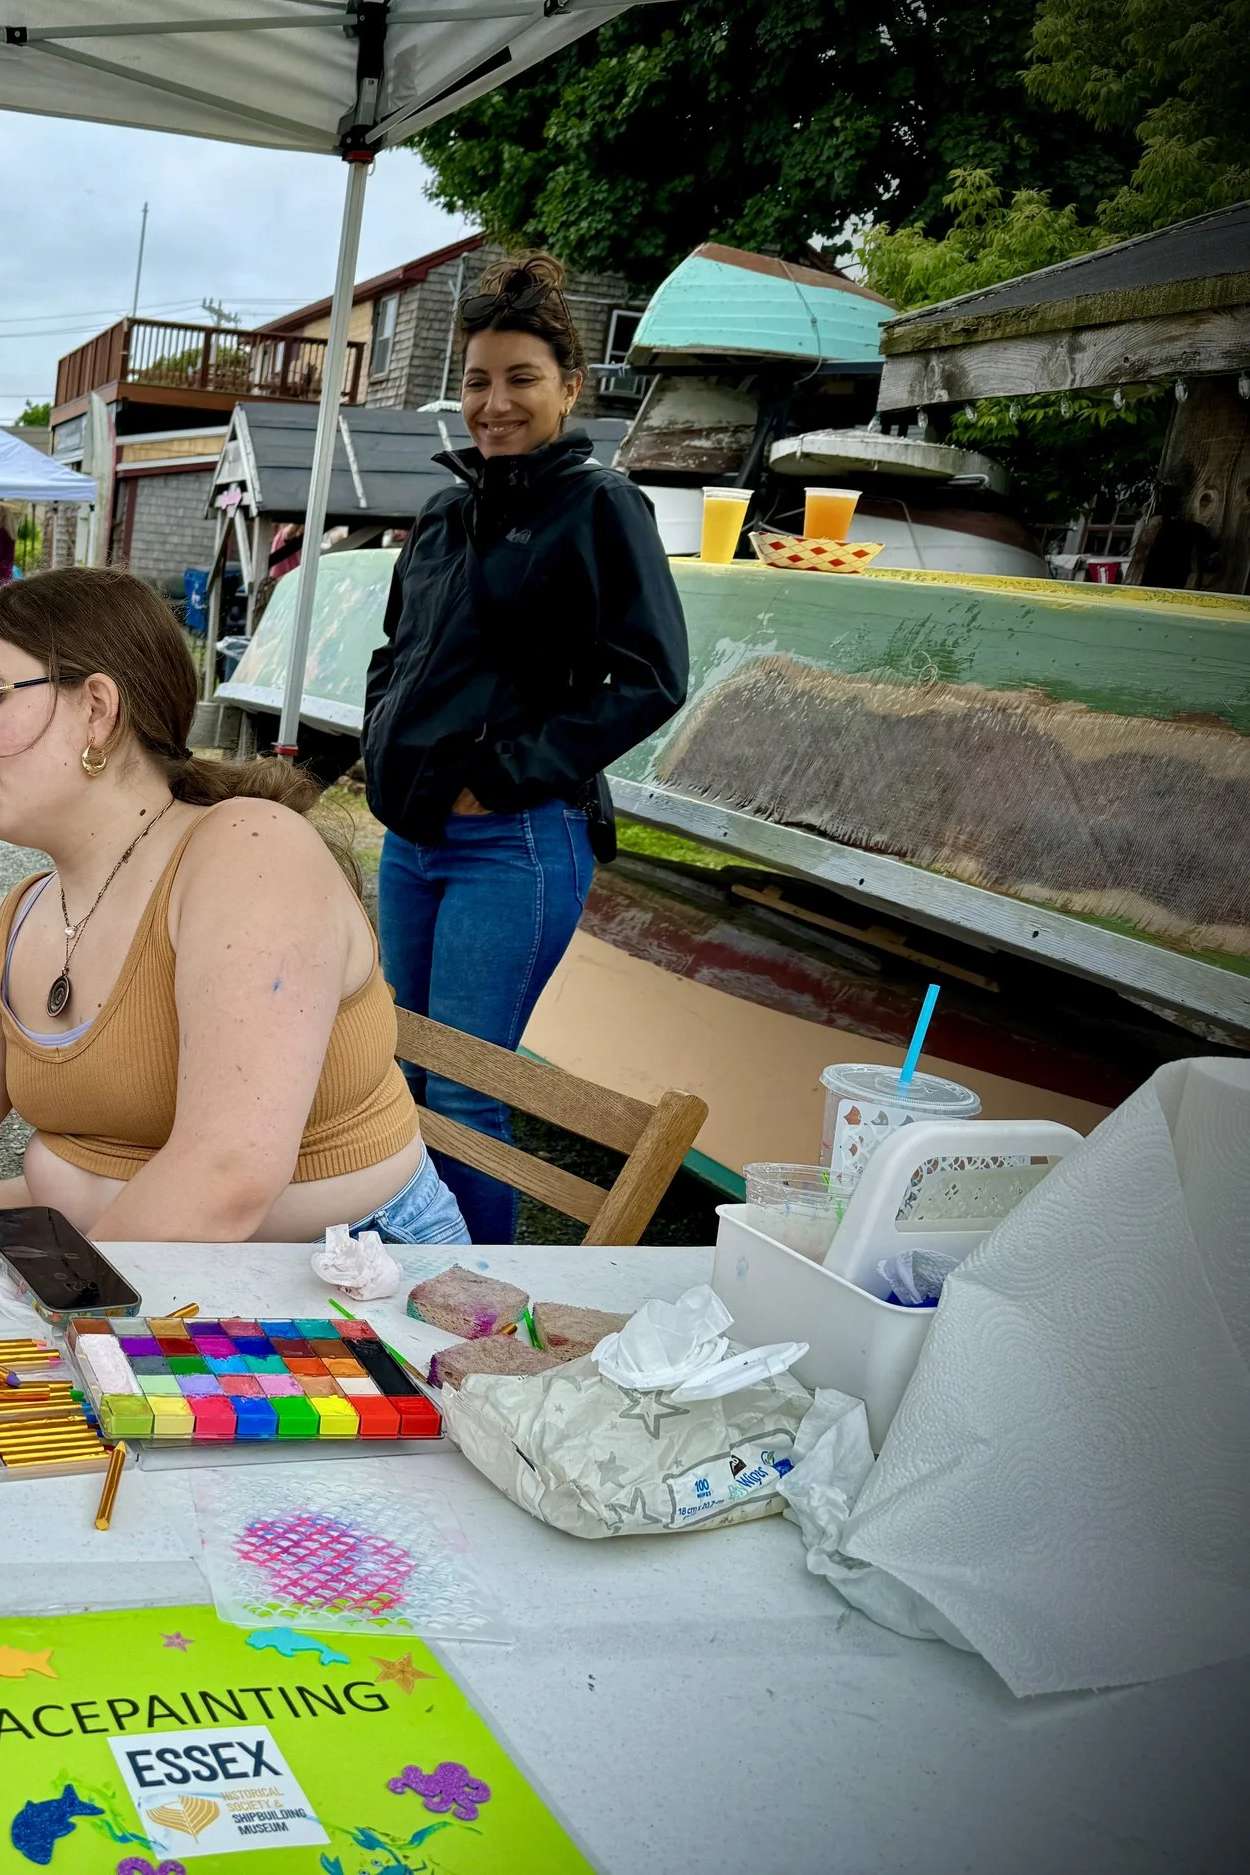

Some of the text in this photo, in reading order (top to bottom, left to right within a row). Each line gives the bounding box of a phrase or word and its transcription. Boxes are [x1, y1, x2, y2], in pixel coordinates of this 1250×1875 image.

[694, 1478, 710, 1492] 100
[126, 1740, 283, 1788] ESSEX
[221, 1786, 284, 1801] HISTORICAL
[226, 1798, 283, 1813] SOCIETY &
[231, 1808, 307, 1824] SHIPBUILDING
[238, 1822, 289, 1836] MUSEUM
